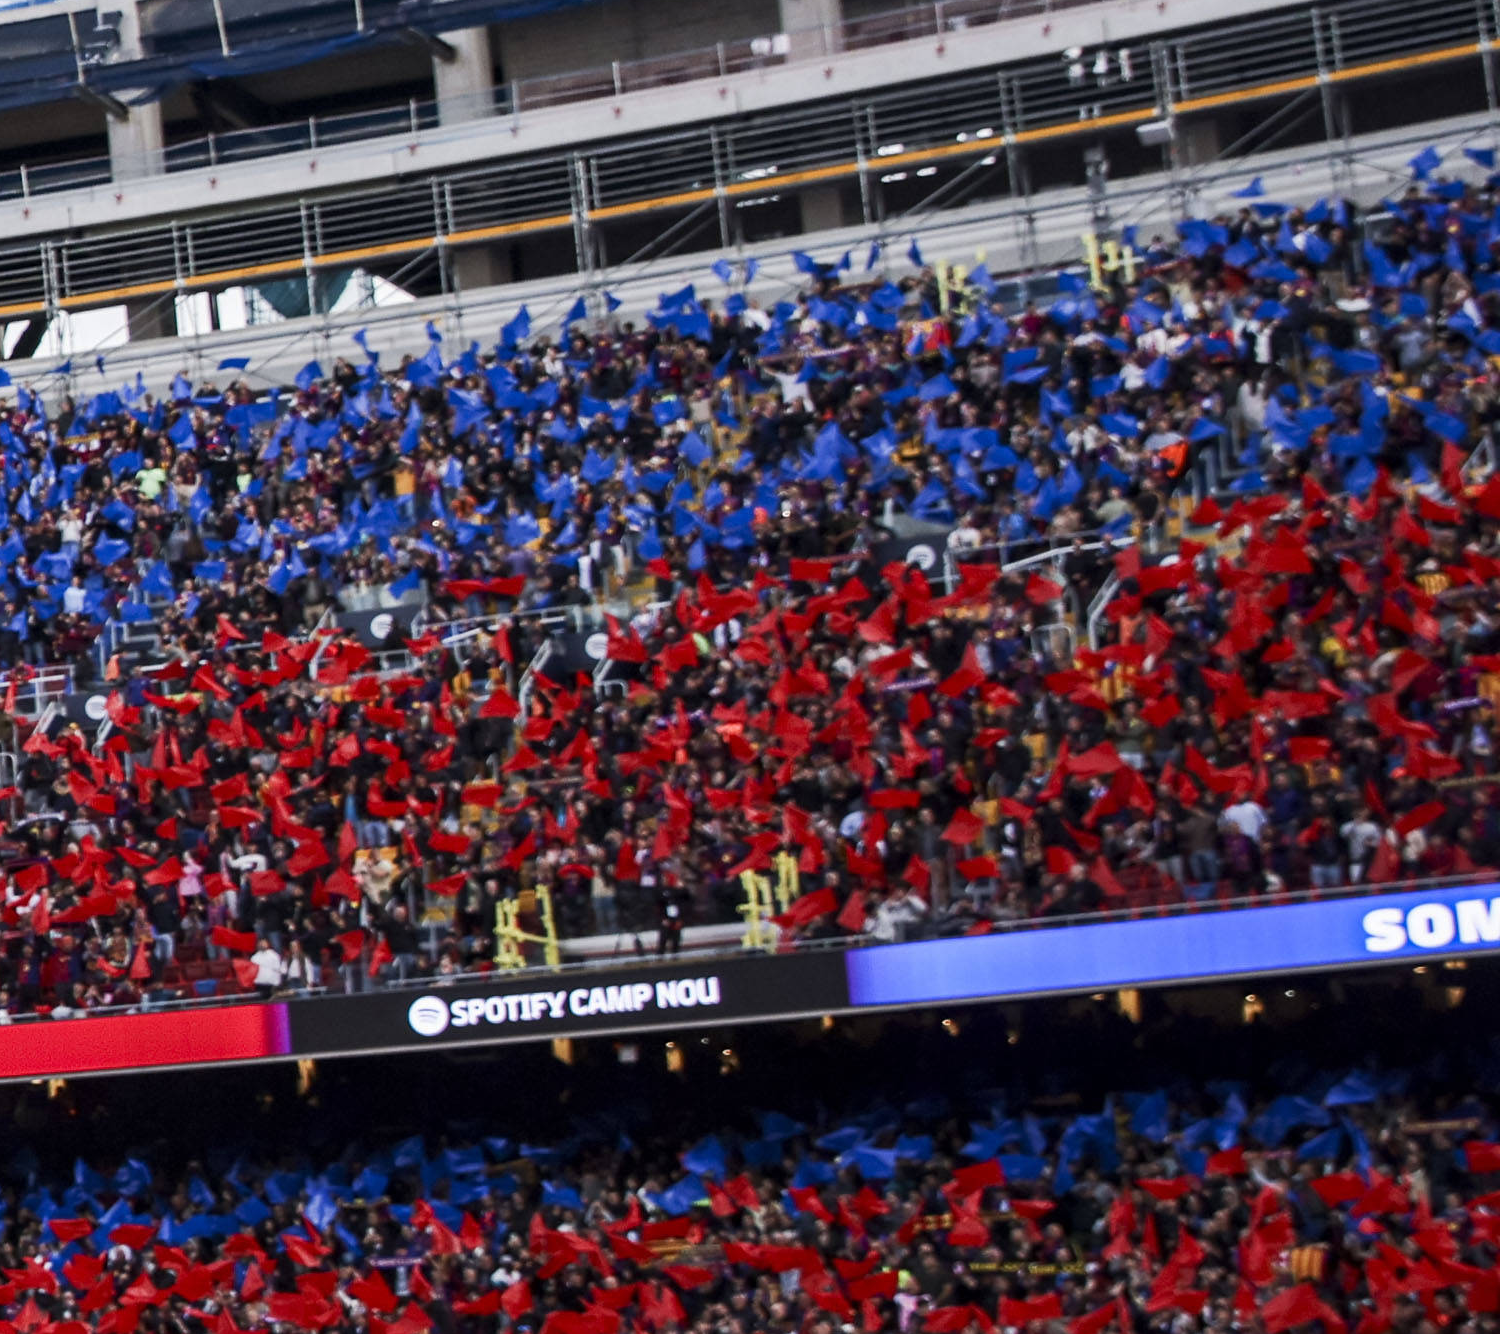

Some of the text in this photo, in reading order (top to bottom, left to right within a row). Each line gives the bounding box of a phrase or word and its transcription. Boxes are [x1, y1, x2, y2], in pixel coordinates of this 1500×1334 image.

[450, 976, 720, 1027] SPOTIFY CAMP NOU
